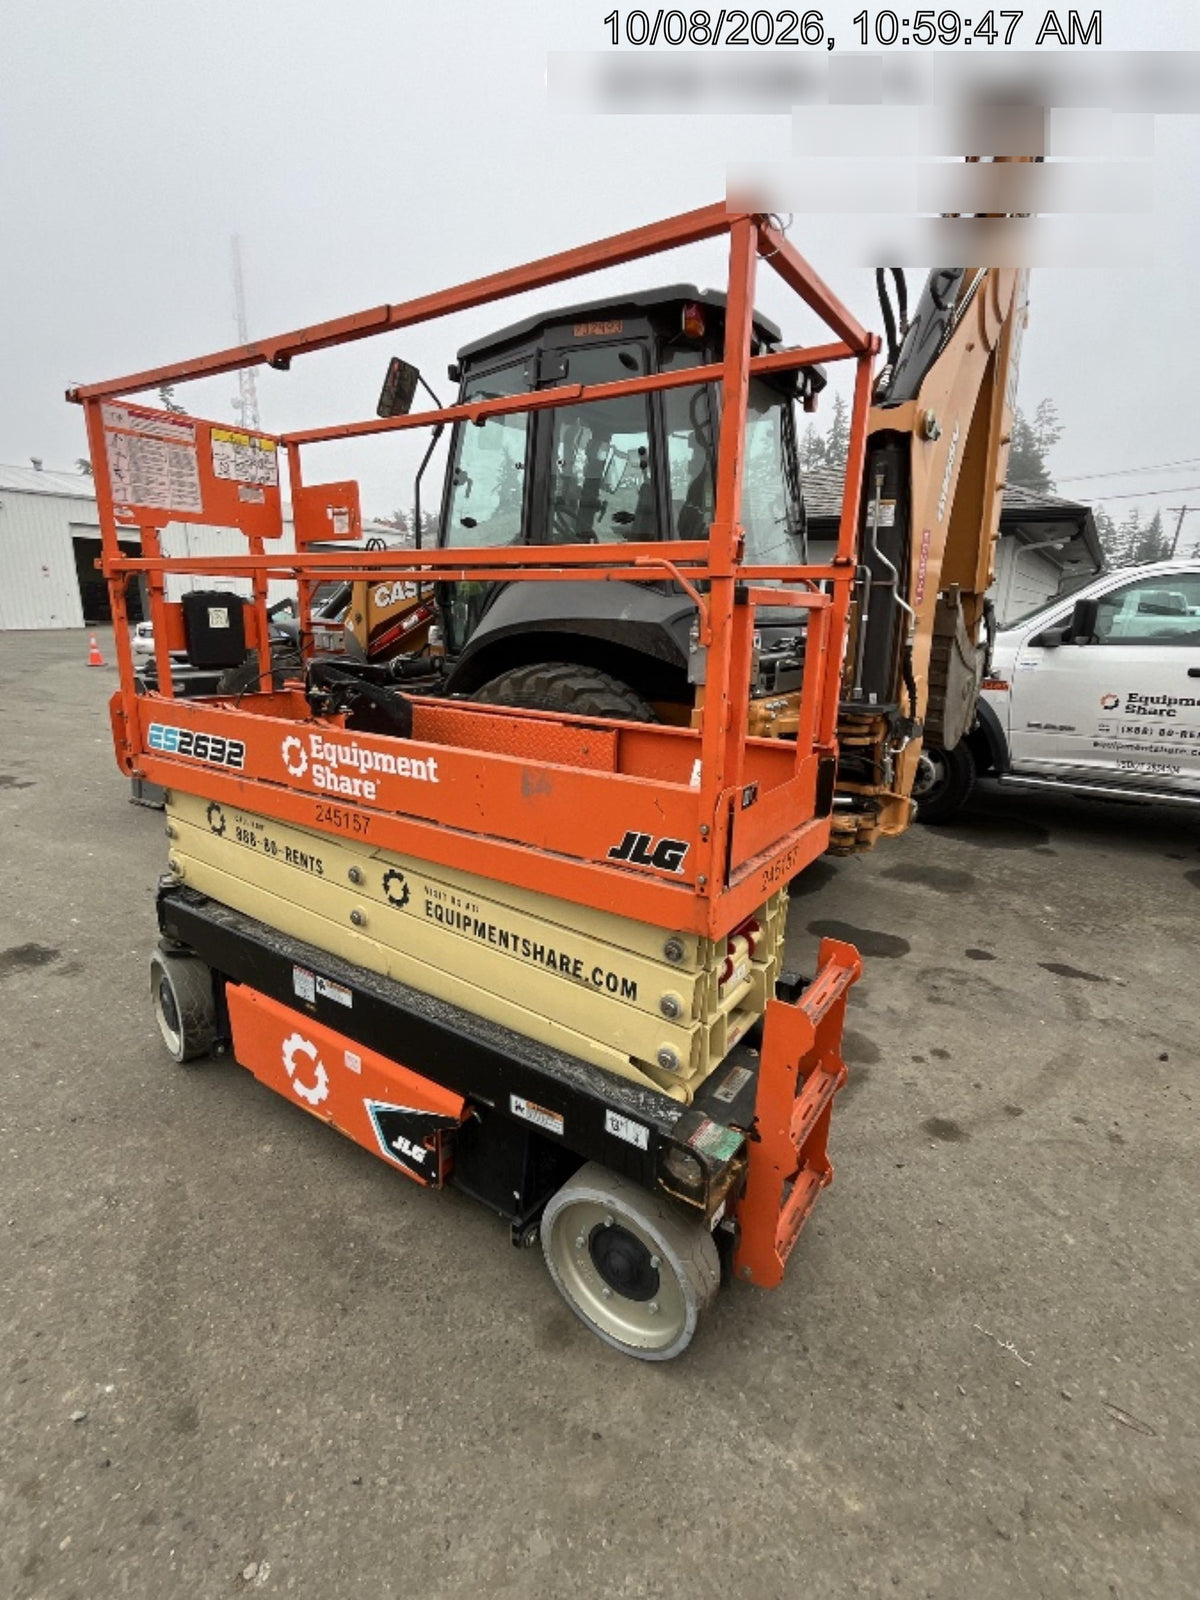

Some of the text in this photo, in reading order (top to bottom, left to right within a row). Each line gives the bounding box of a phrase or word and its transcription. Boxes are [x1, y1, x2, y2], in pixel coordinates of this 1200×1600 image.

[1125, 704, 1177, 718] Share
[148, 723, 245, 769] ES2632
[309, 734, 440, 783] Equipment
[312, 764, 377, 800] Share
[315, 804, 371, 835] 245157
[236, 826, 324, 875] 888-80-RENTS
[607, 831, 690, 874] JLG
[425, 900, 638, 1001] EQUIPMENTSHARE.COM
[392, 1135, 427, 1164] JLG
